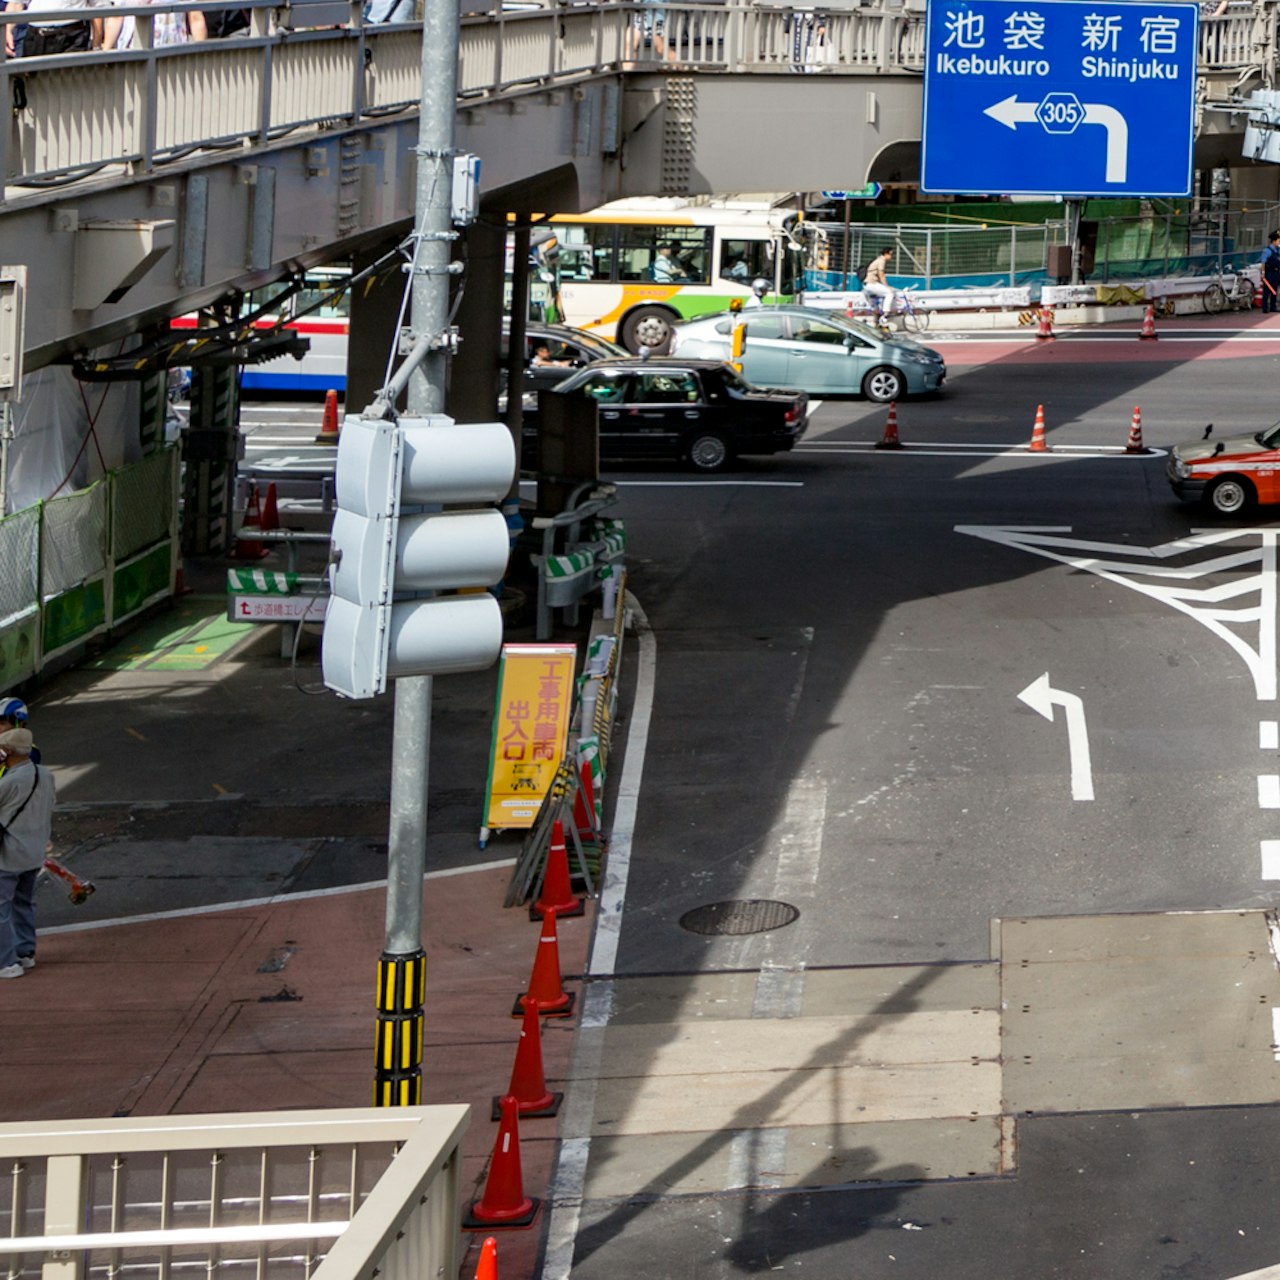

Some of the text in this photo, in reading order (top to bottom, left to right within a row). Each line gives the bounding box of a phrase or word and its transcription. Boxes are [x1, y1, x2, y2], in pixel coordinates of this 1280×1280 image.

[943, 9, 1180, 54] 池袋 新宿
[936, 53, 1179, 83] Ikebukuro Shinjuku
[1043, 103, 1077, 124] 305
[502, 699, 531, 762] 出入口
[531, 660, 563, 762] 工事用車両
